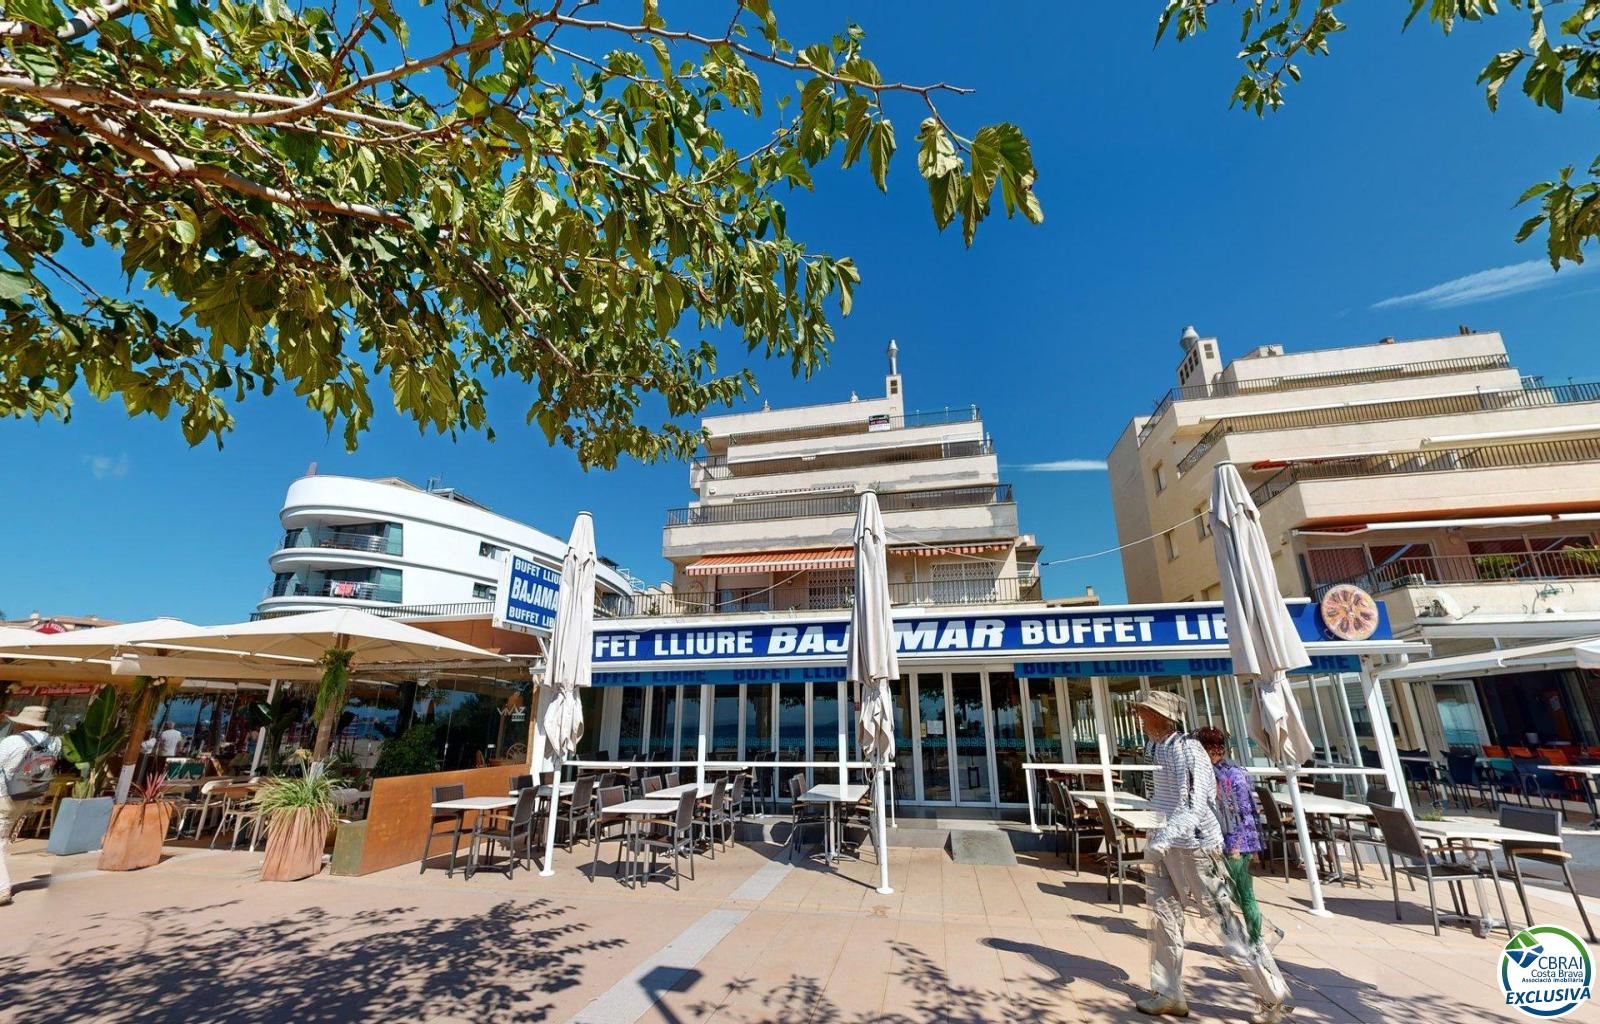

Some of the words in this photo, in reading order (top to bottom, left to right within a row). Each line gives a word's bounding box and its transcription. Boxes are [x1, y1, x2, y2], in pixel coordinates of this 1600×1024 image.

[514, 558, 541, 578] BUFET
[543, 569, 561, 586] LLIU
[511, 576, 559, 612] BAJAMA
[508, 605, 540, 624] BUFFET
[542, 614, 556, 628] LIB
[594, 634, 641, 658] FET
[654, 631, 754, 656] LLIURE
[1021, 616, 1155, 645] BUFFET
[592, 672, 641, 683] UFFET
[803, 667, 847, 680] LLIU
